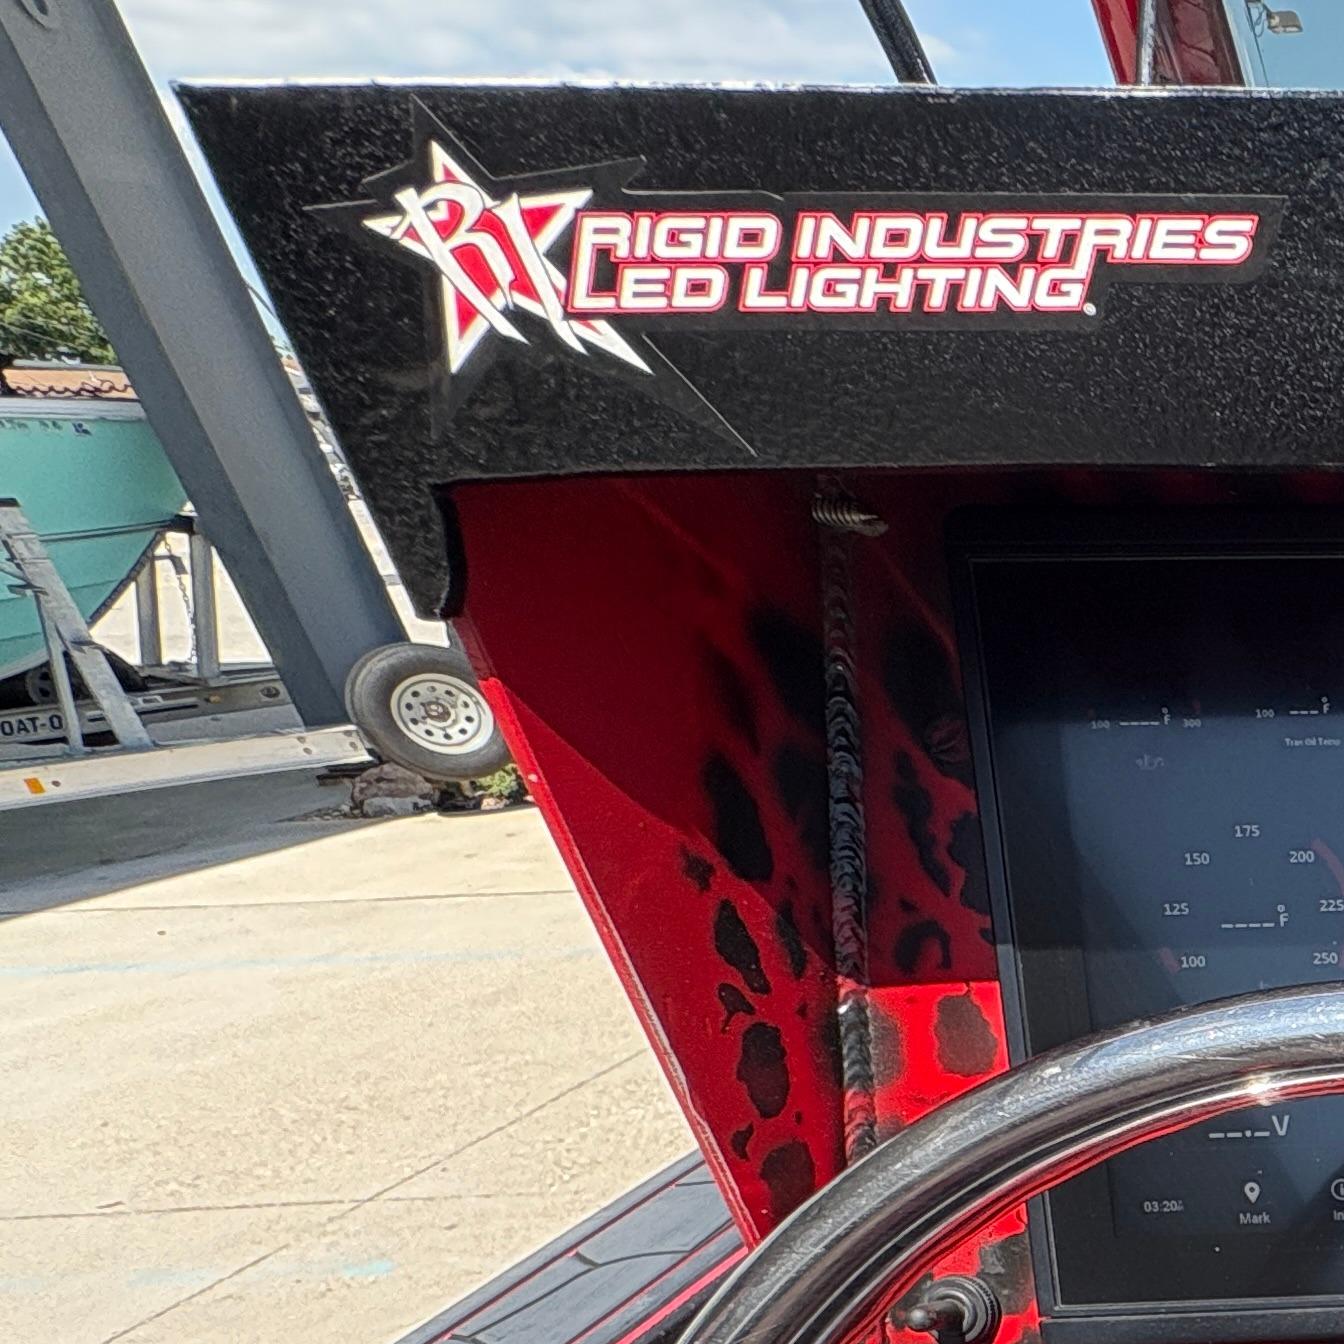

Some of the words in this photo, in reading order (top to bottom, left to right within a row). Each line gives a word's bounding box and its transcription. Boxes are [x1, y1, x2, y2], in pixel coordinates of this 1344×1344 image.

[577, 213, 780, 263] RIGID
[793, 212, 1258, 264] INDUSTRIES
[568, 252, 727, 312] LED
[740, 264, 1088, 313] LIGHTING
[1234, 825, 1261, 838] 175
[1184, 852, 1211, 865] 150
[1289, 851, 1315, 863] 200
[1163, 902, 1190, 915] 125
[1319, 899, 1344, 912] 225
[1180, 956, 1206, 968] 100
[1312, 952, 1338, 965] 250
[1239, 1212, 1271, 1225] Mark
